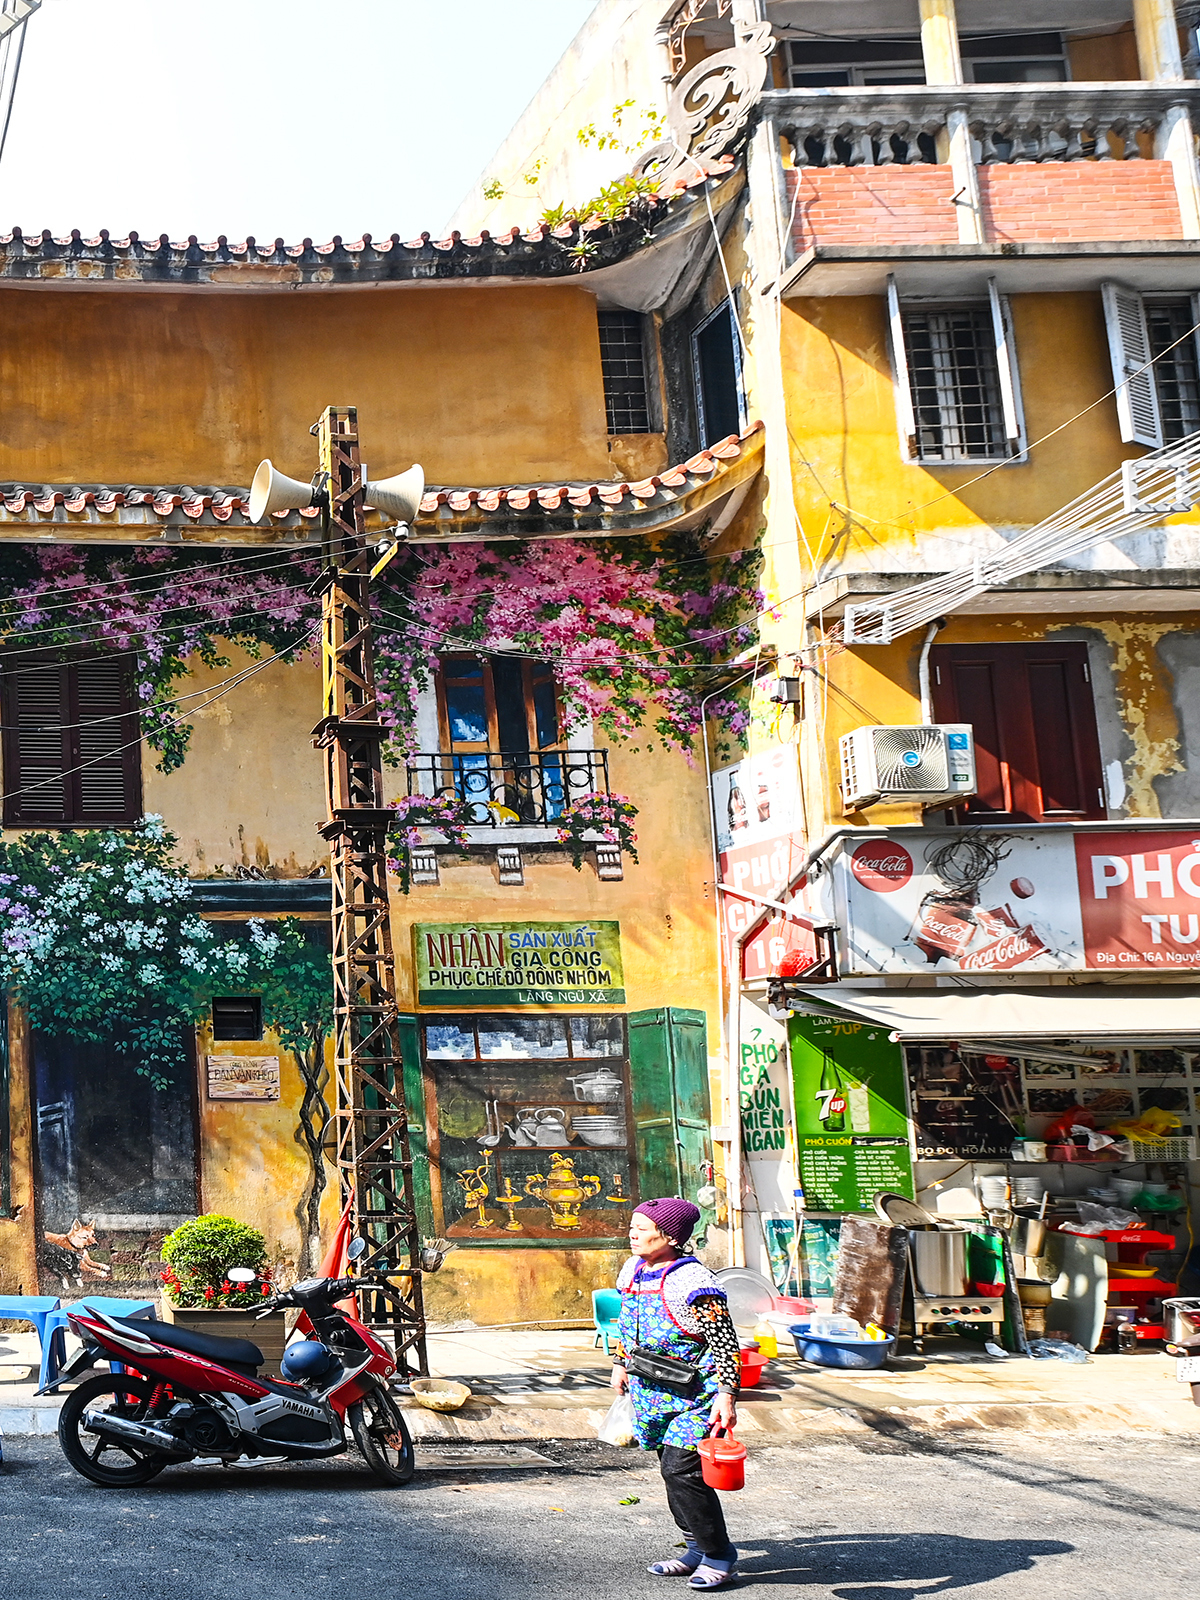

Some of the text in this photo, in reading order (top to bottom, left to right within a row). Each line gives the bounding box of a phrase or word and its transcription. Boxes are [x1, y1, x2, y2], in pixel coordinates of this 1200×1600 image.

[853, 856, 909, 871] Coca-Cola
[426, 926, 597, 969] NHẬN SẢN XUẤT
[965, 928, 1032, 969] Coca-Cola
[511, 948, 602, 968] GIA CÔNG
[1096, 952, 1116, 963] Địa
[1142, 952, 1164, 962] 16A
[429, 970, 474, 989] PHỤC
[526, 966, 564, 985] ĐỒNG
[567, 967, 612, 985] NHÔM
[519, 988, 608, 1002] LÀNG NGŨ XÃ
[833, 1024, 863, 1036] 7UP
[281, 1399, 315, 1417] YAMAHA
